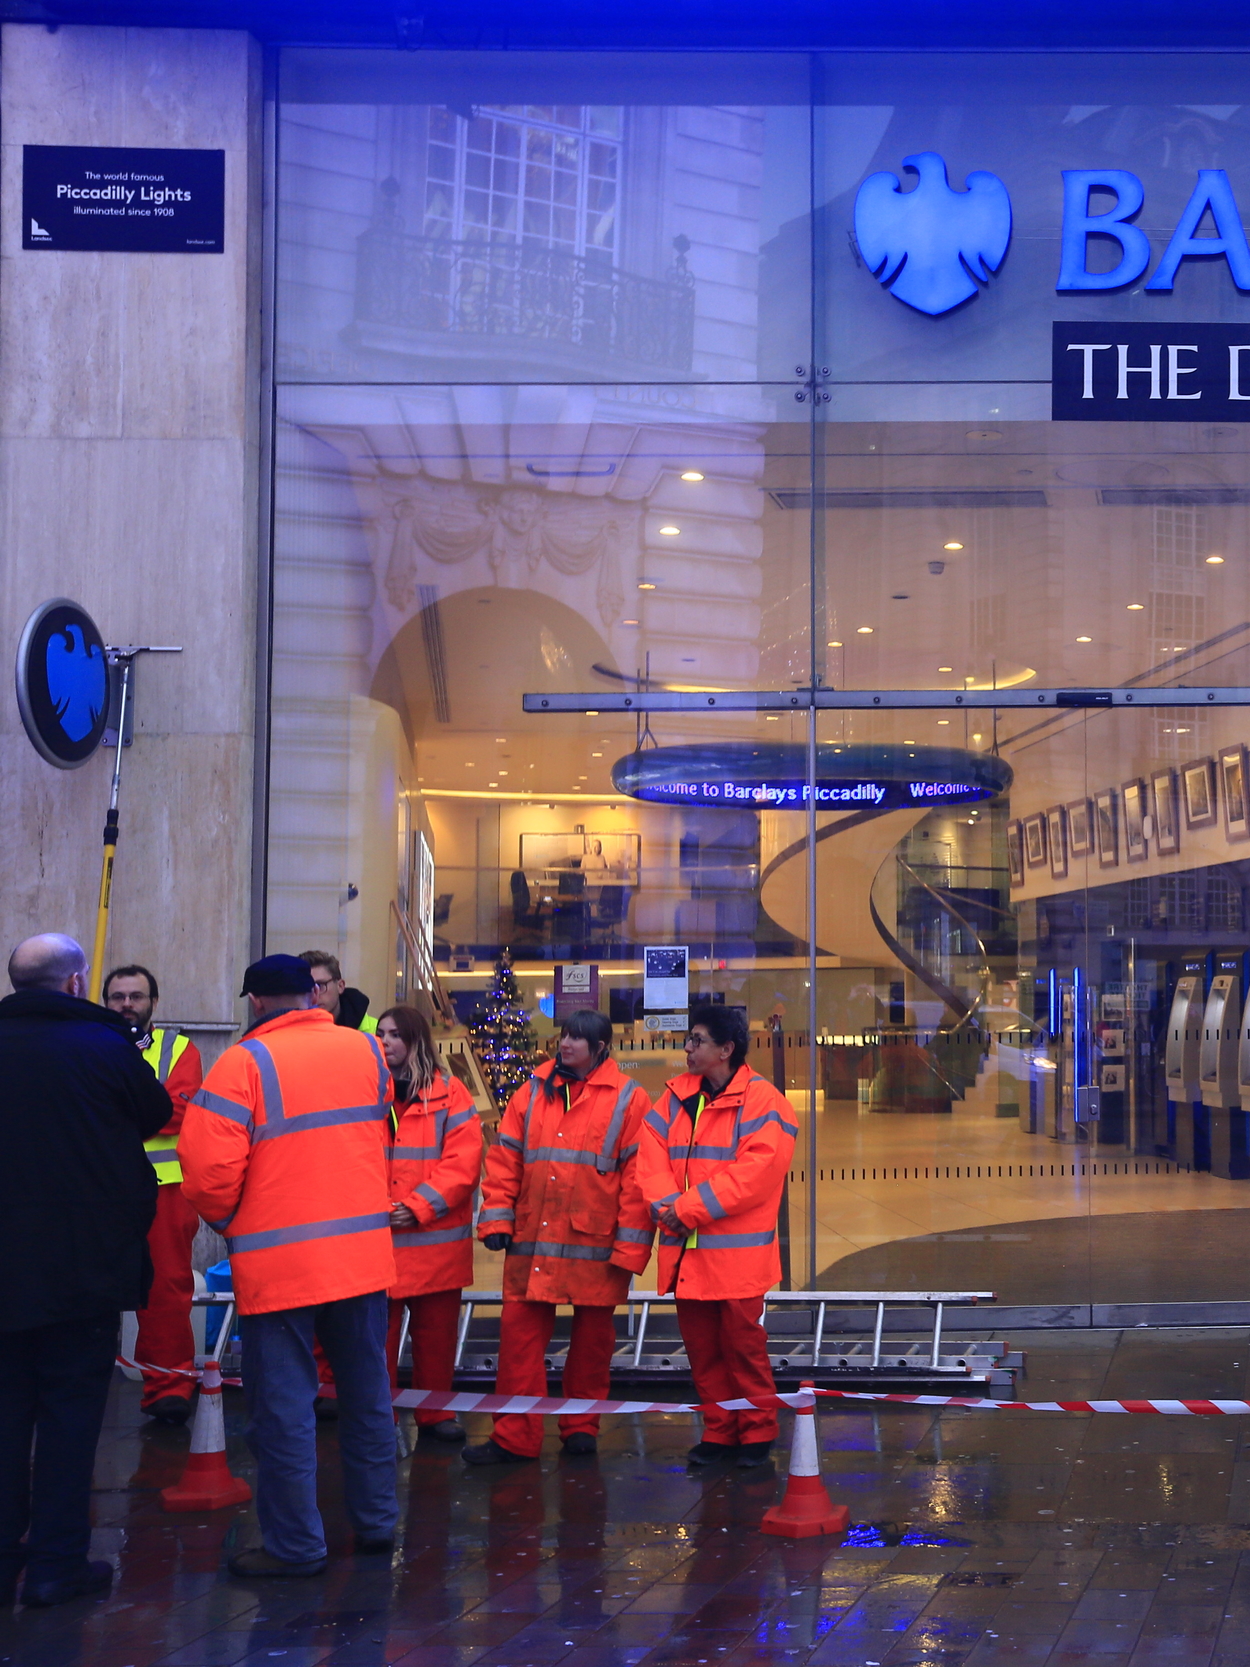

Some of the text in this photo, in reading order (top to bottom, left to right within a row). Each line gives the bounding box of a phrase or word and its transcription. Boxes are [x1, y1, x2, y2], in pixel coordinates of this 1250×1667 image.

[84, 171, 165, 182] The world famous
[56, 184, 192, 205] Piccadilly Lights
[73, 206, 175, 217] illuminated since 1908
[1065, 343, 1202, 401] THE
[701, 782, 720, 797] to
[724, 782, 797, 805] Barclays
[802, 783, 886, 805] Piccadilly
